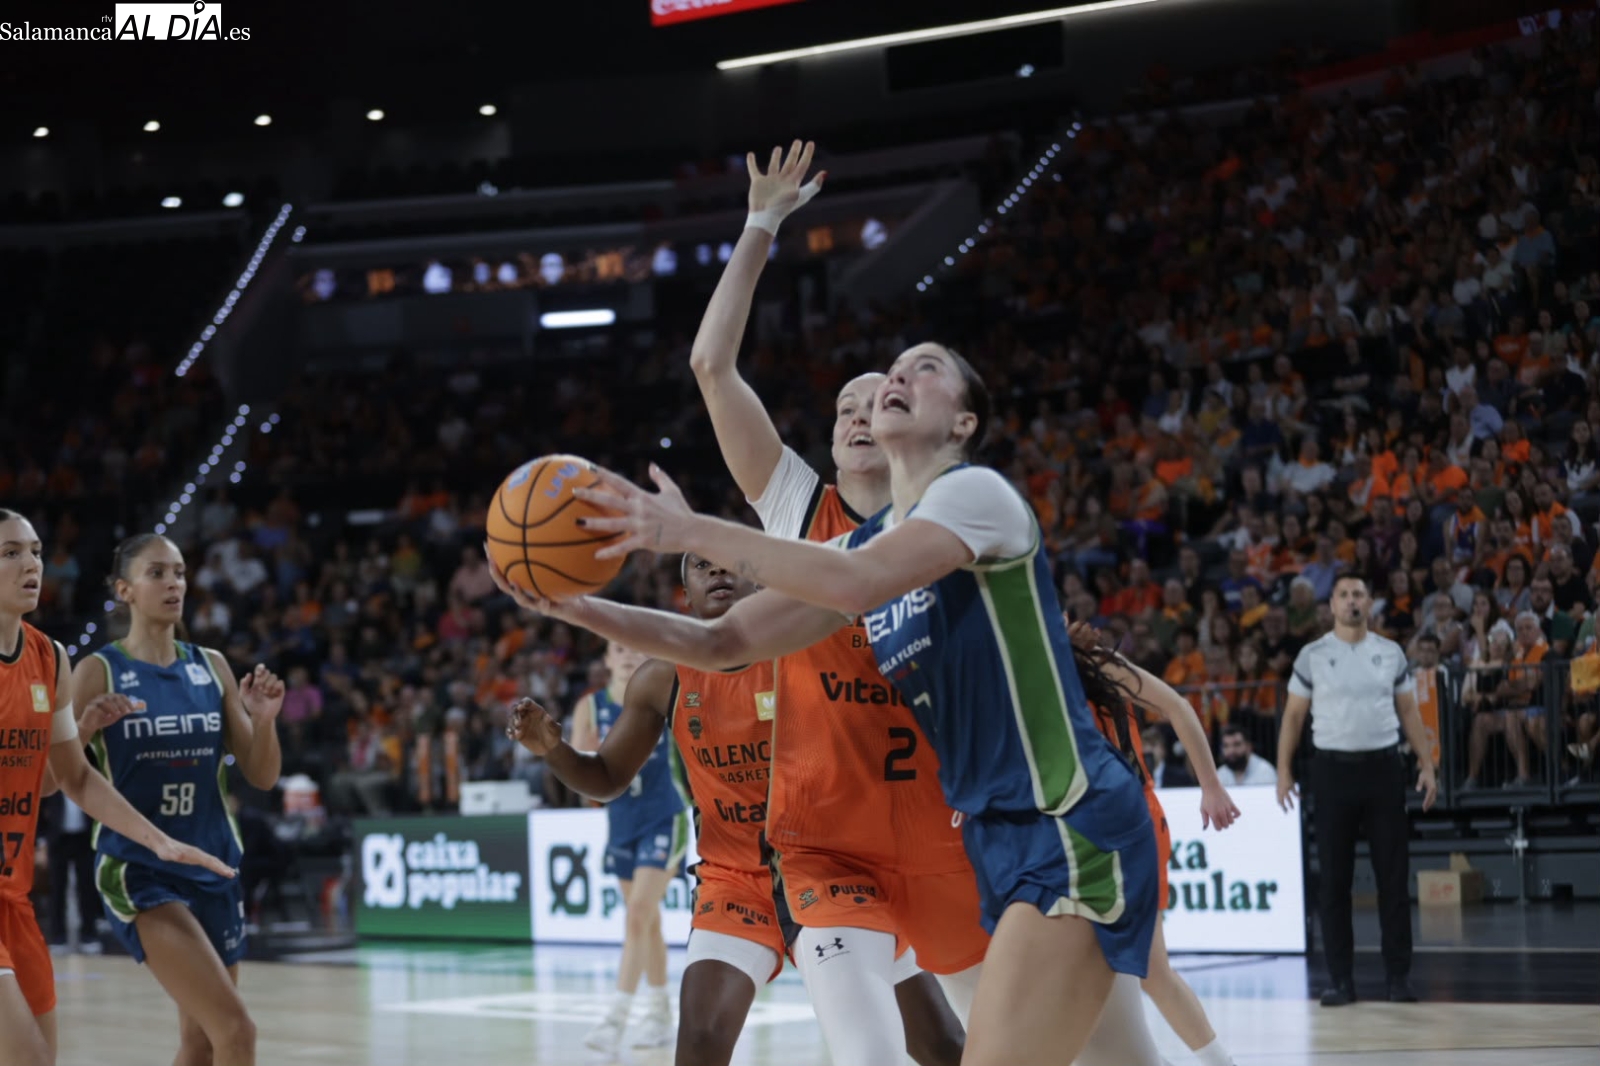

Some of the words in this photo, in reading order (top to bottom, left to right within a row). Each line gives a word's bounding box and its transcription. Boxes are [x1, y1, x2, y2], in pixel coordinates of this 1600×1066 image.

[160, 782, 196, 816] 58
[406, 832, 479, 870] caixa
[408, 863, 521, 909] popular
[829, 883, 877, 898] PULEVA
[726, 902, 770, 926] PULEVA
